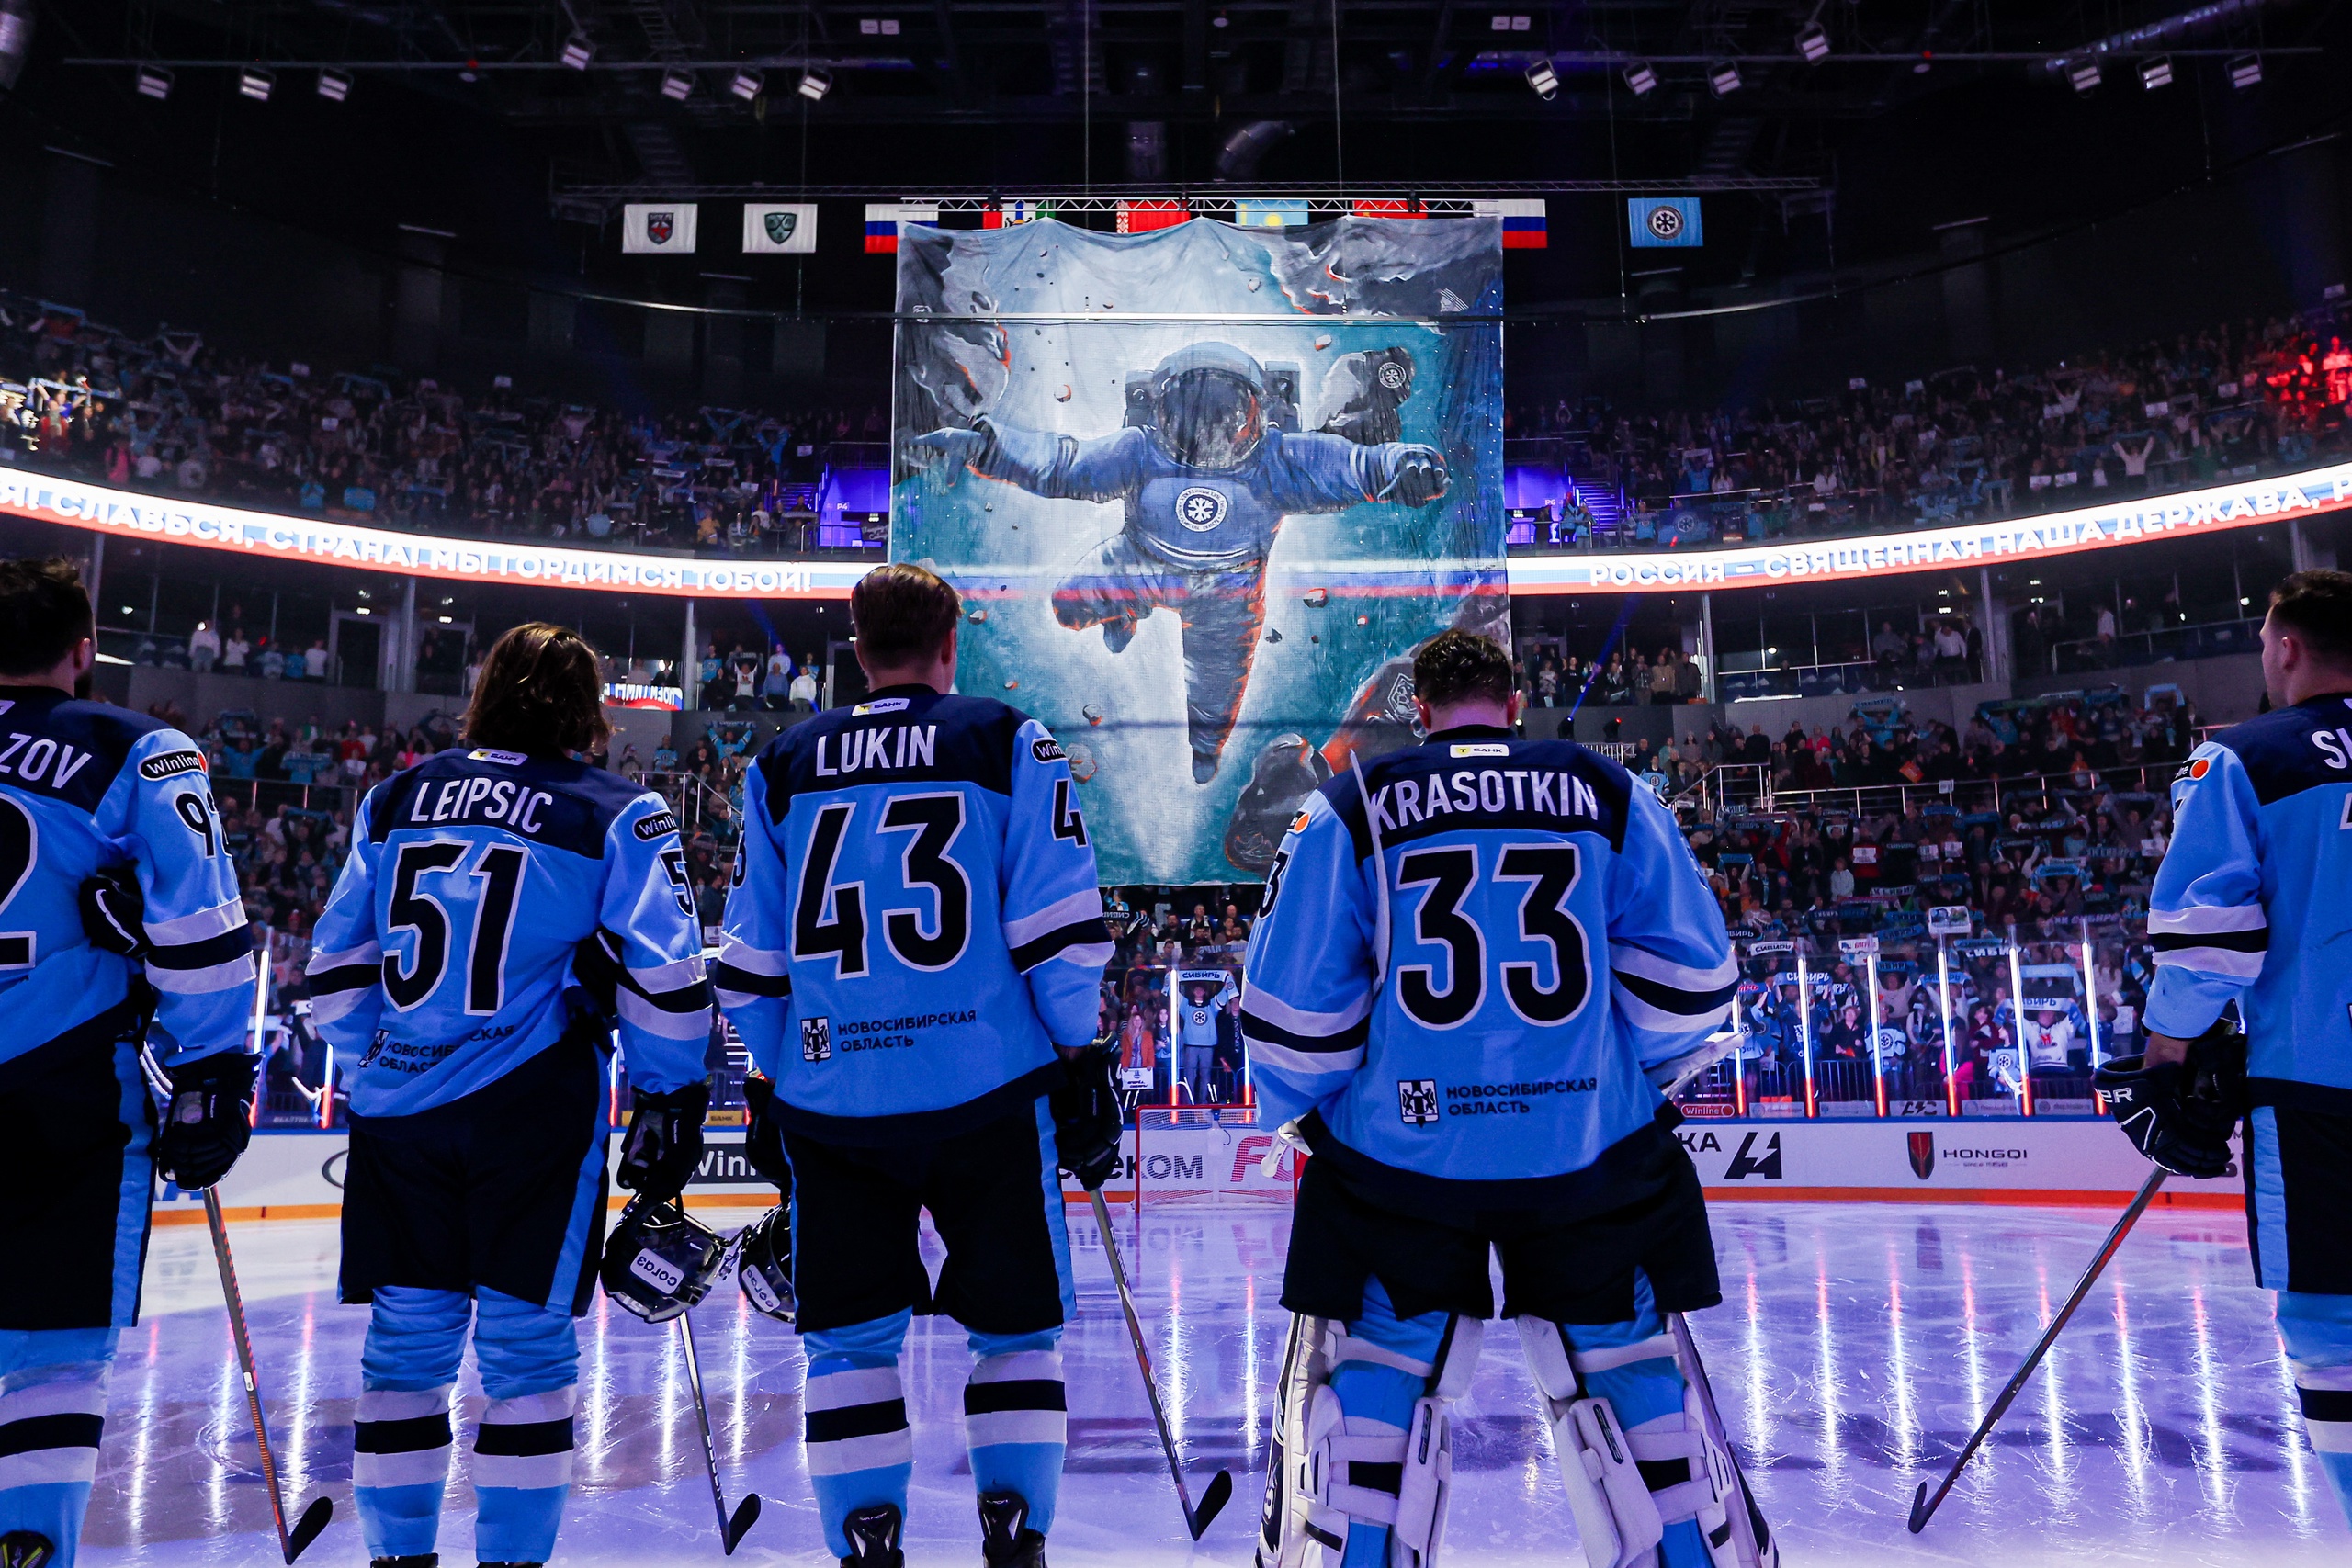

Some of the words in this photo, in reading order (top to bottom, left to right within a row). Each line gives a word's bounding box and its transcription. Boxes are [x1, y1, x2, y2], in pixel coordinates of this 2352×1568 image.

[50, 491, 254, 548] СЛАВЬСЯ,
[265, 526, 419, 569] СТРАНА!
[430, 548, 489, 574] МЫ
[499, 551, 683, 589] ГОРДИМСЯ
[689, 561, 812, 592] ТОБОЙ!
[1590, 558, 1725, 586] РОССИЯ
[1763, 538, 1982, 578] СВЯЩЕННАЯ
[1993, 520, 2106, 556] НАША
[2113, 485, 2320, 542] ДЕРЖАВА,
[145, 754, 199, 775] Winline
[816, 725, 937, 777] LUKIN
[410, 776, 553, 834] LEIPSIC
[1373, 770, 1599, 835] KRASOTKIN
[792, 790, 972, 981] 43
[382, 838, 531, 1017] 51
[1395, 842, 1592, 1031] 33
[837, 1010, 977, 1036] НОВОСИБИРСКАЯ
[384, 1024, 515, 1058] НОВОСИБСКАЯ
[840, 1034, 915, 1053] ОБЛАСТЬ
[379, 1055, 438, 1074] ОБЛАС
[1446, 1077, 1598, 1099] НОВОСИБИРСКАЯ
[1448, 1100, 1531, 1116] ОБЛАСТЬ
[1685, 1106, 1720, 1115] Winline
[1943, 1149, 2028, 1159] HONGQI
